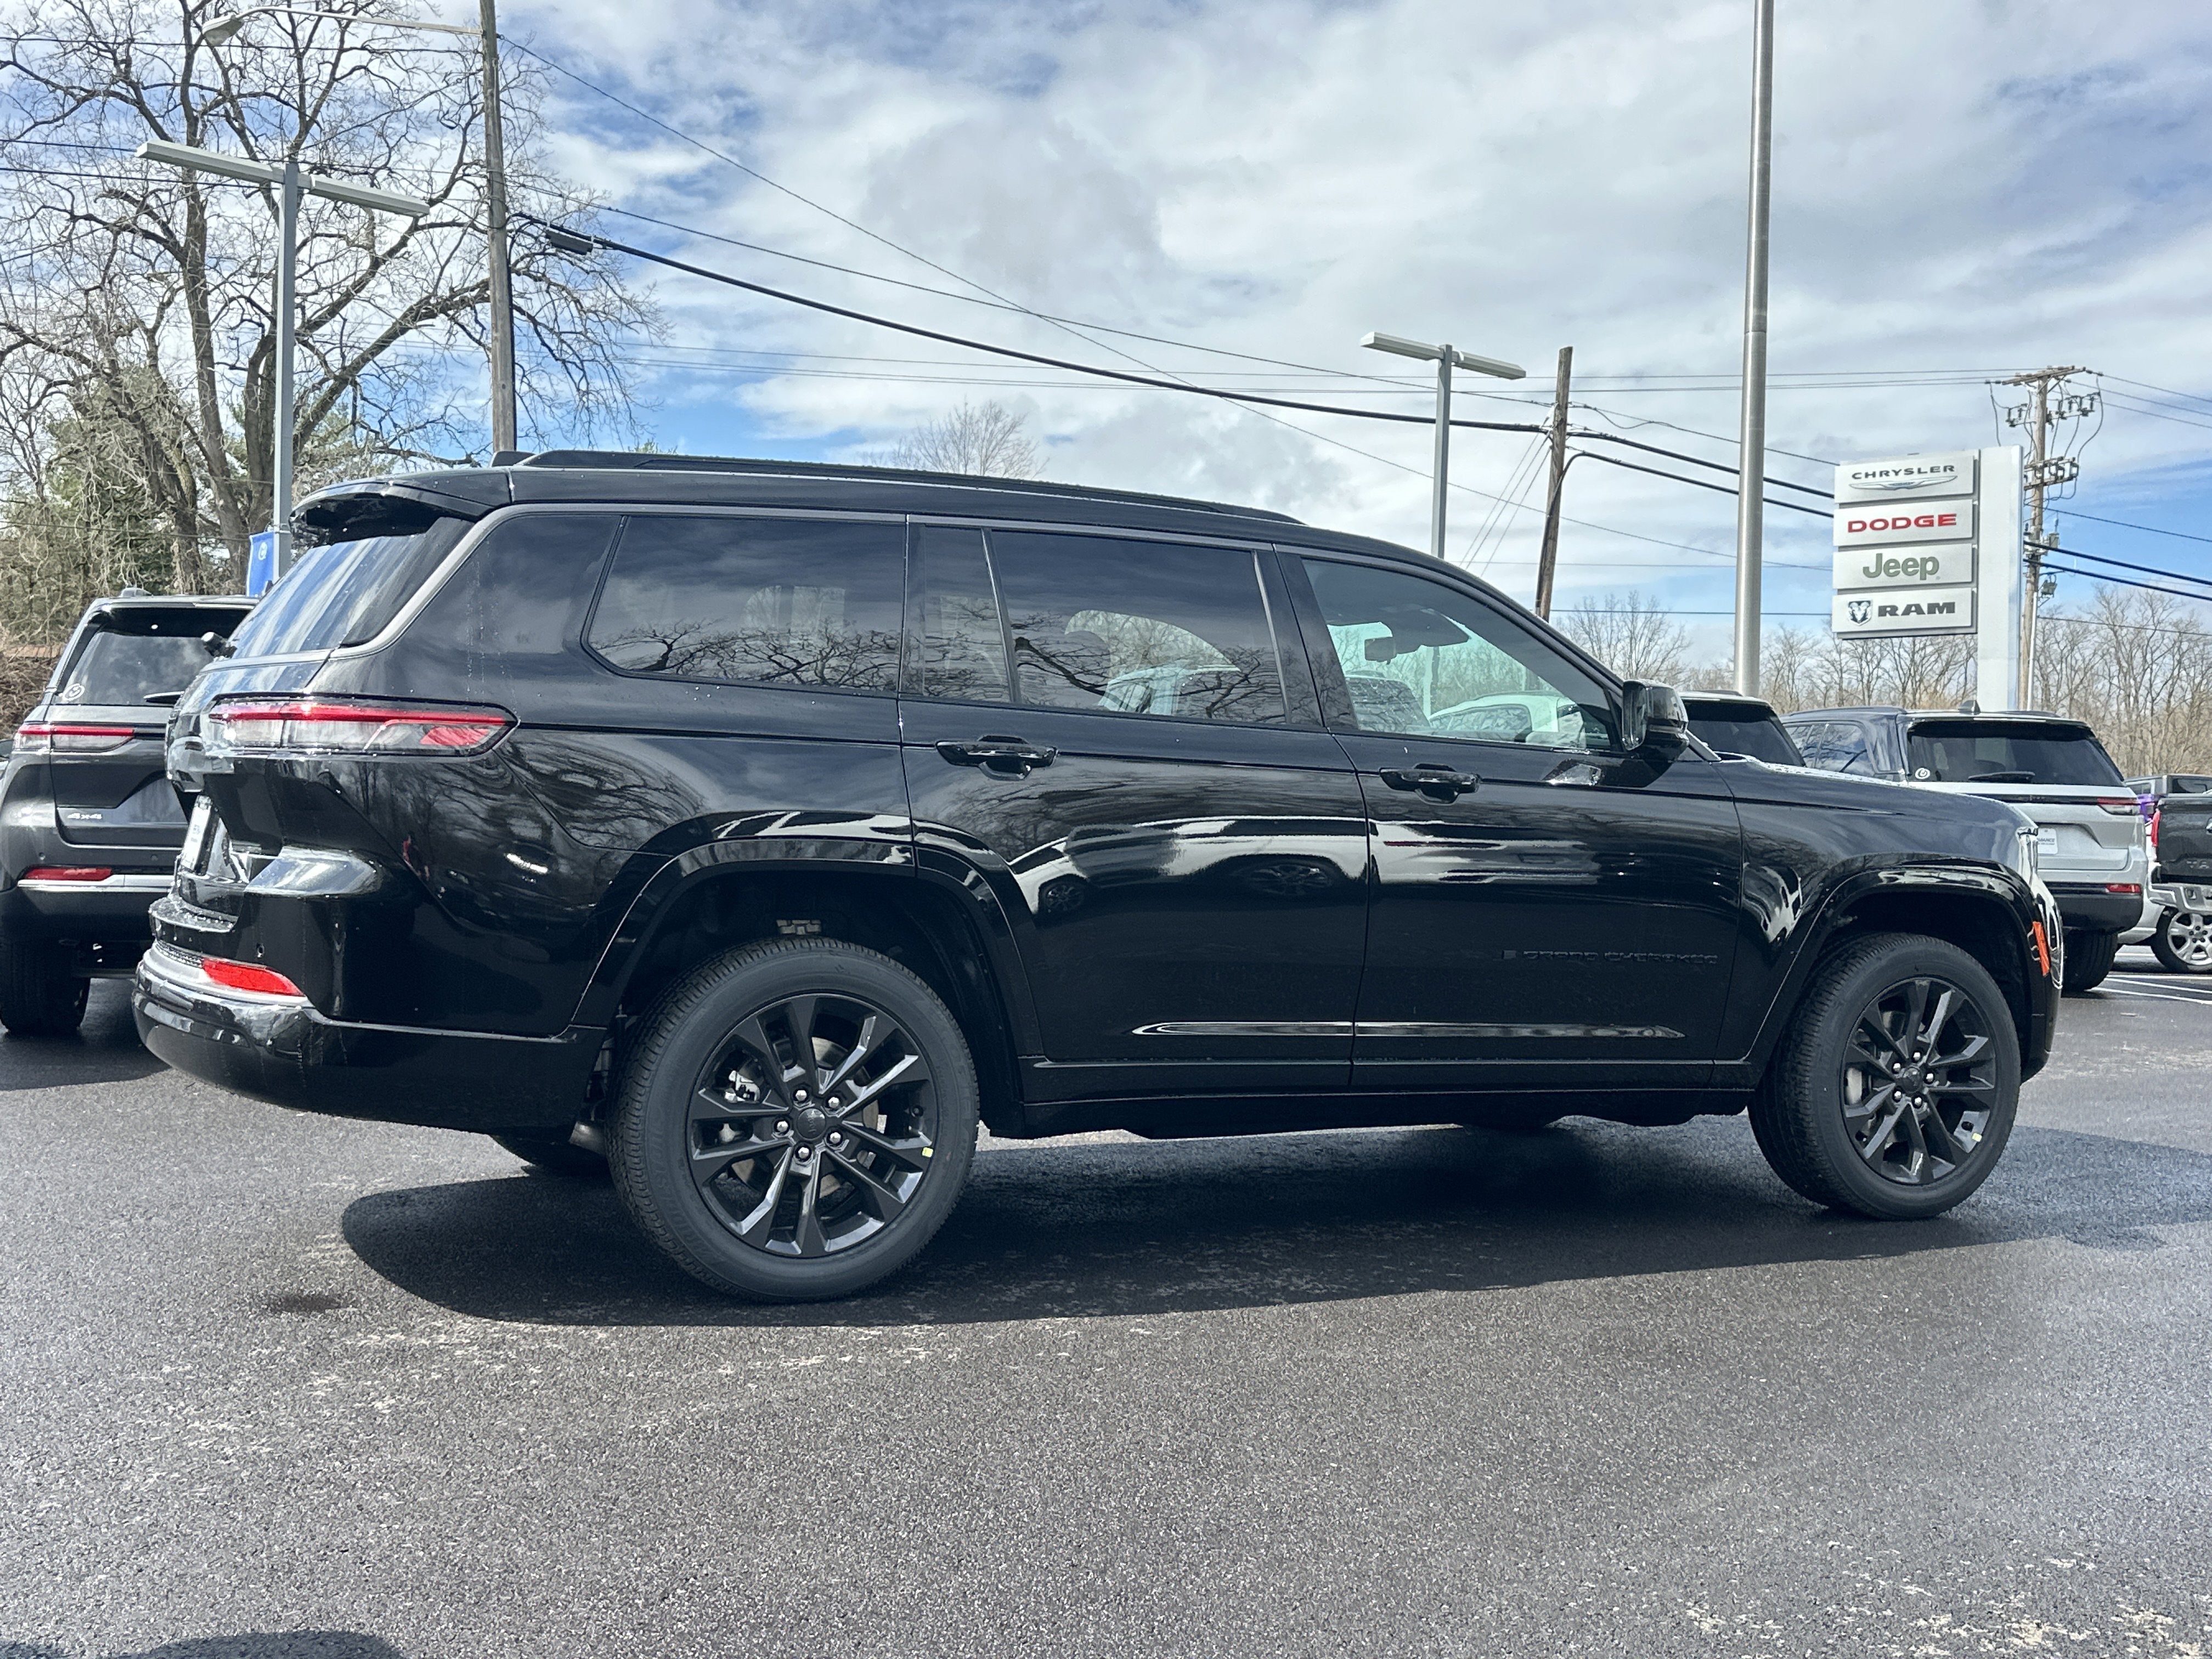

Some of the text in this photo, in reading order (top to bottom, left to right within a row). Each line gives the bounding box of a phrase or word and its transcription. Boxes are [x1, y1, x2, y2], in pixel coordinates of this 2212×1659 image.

[1852, 465, 1955, 479] CHRYSLER
[1848, 514, 1957, 533] DODGE
[1863, 553, 1940, 580] Jeep
[1878, 602, 1955, 617] RAM
